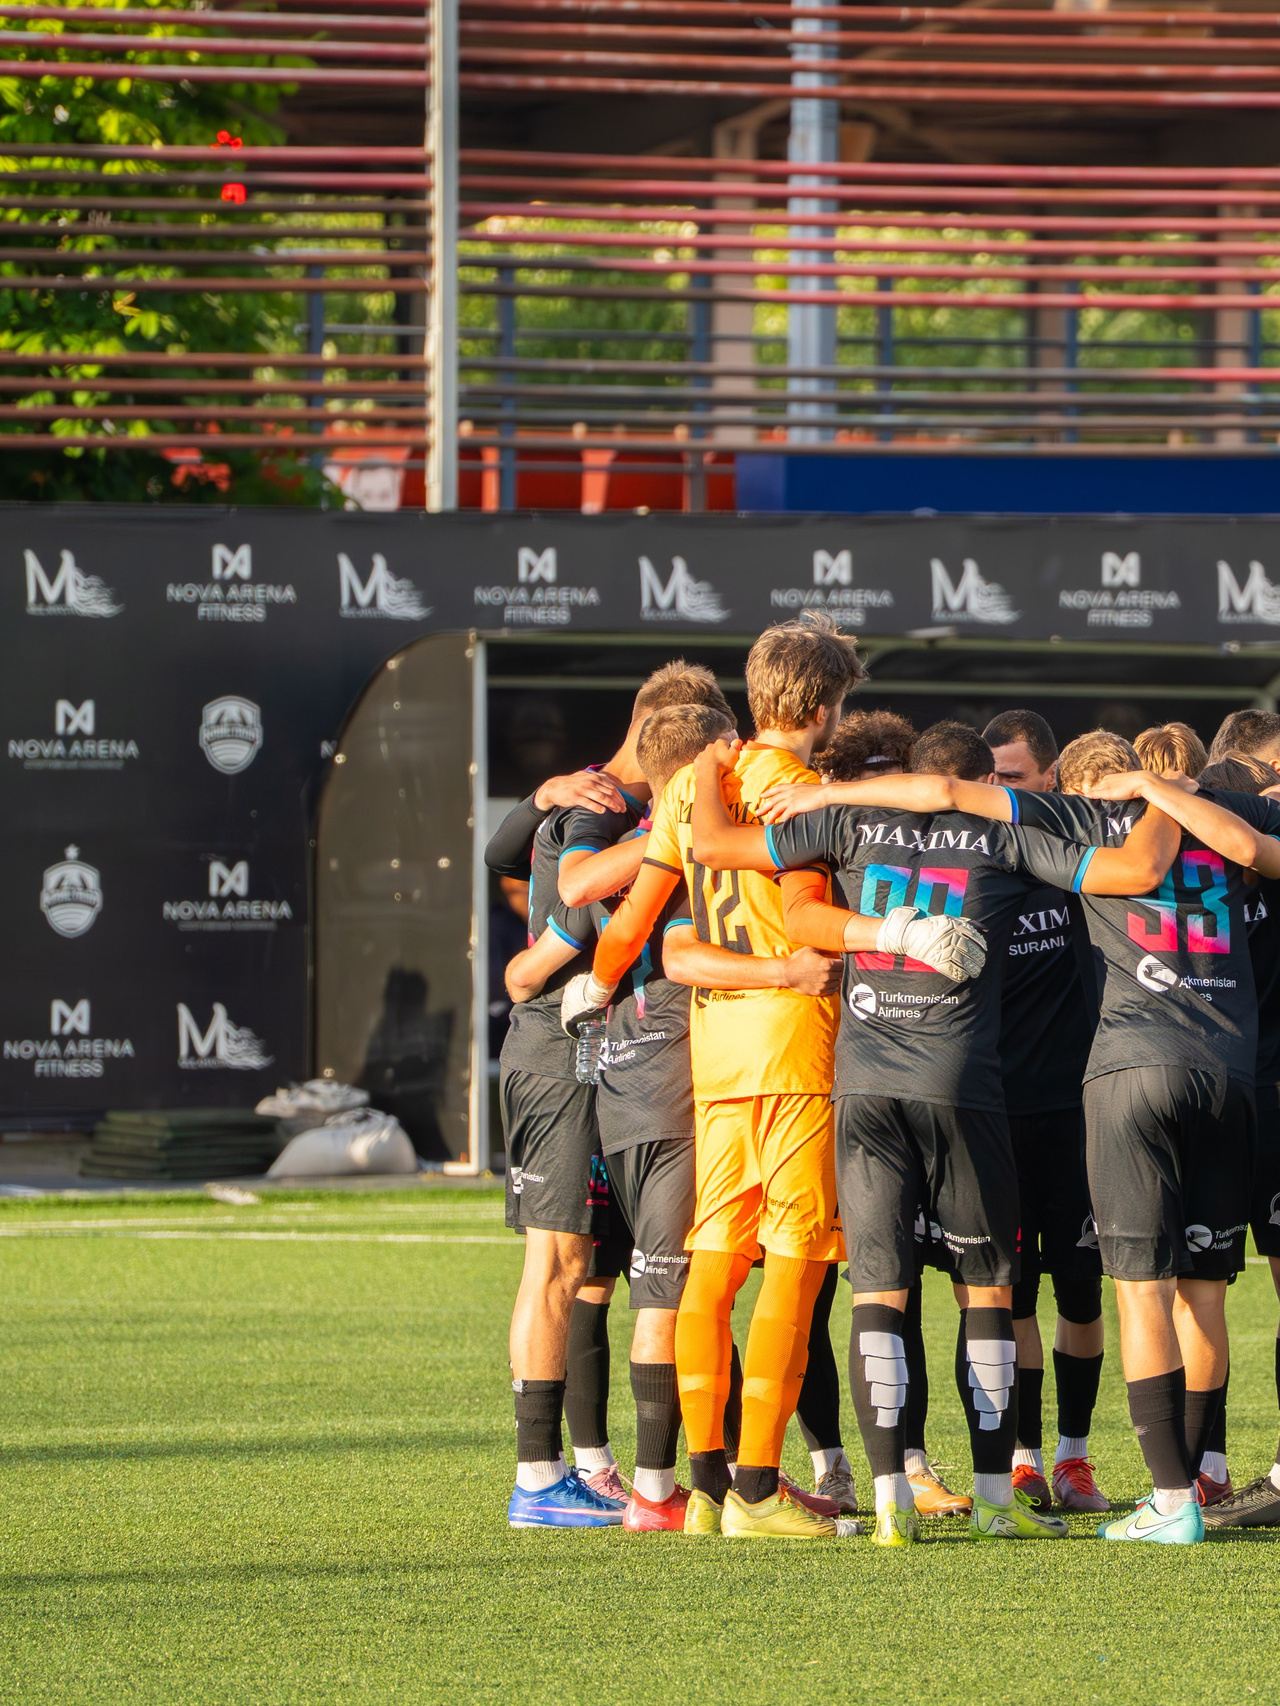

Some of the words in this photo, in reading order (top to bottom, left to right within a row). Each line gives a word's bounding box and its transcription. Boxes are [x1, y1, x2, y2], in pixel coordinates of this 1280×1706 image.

[167, 583, 224, 602] NOVA
[226, 584, 297, 603] ARENA
[474, 586, 530, 606] NOVA
[532, 586, 600, 606] ARENA
[771, 589, 825, 607] NOVA
[826, 589, 894, 607] ARENA
[1059, 590, 1115, 609] NOVA
[1116, 590, 1181, 609] ARENA
[198, 603, 266, 622] FITNESS
[504, 606, 571, 625] FITNESS
[1088, 609, 1153, 627] FITNESS
[8, 739, 66, 759] NOVA
[68, 739, 139, 759] ARENA
[858, 823, 991, 856] MAXIMA
[163, 901, 220, 920] NOVA
[222, 900, 292, 919] ARENA
[1013, 905, 1070, 936] XIM
[1008, 935, 1065, 956] SURANI
[712, 992, 746, 1002] Airlines
[878, 991, 959, 1005] Turkmenistan
[877, 1007, 921, 1018] Airlines
[4, 1040, 61, 1059] NOVA
[64, 1039, 135, 1058] ARENA
[35, 1059, 103, 1077] FITNESS
